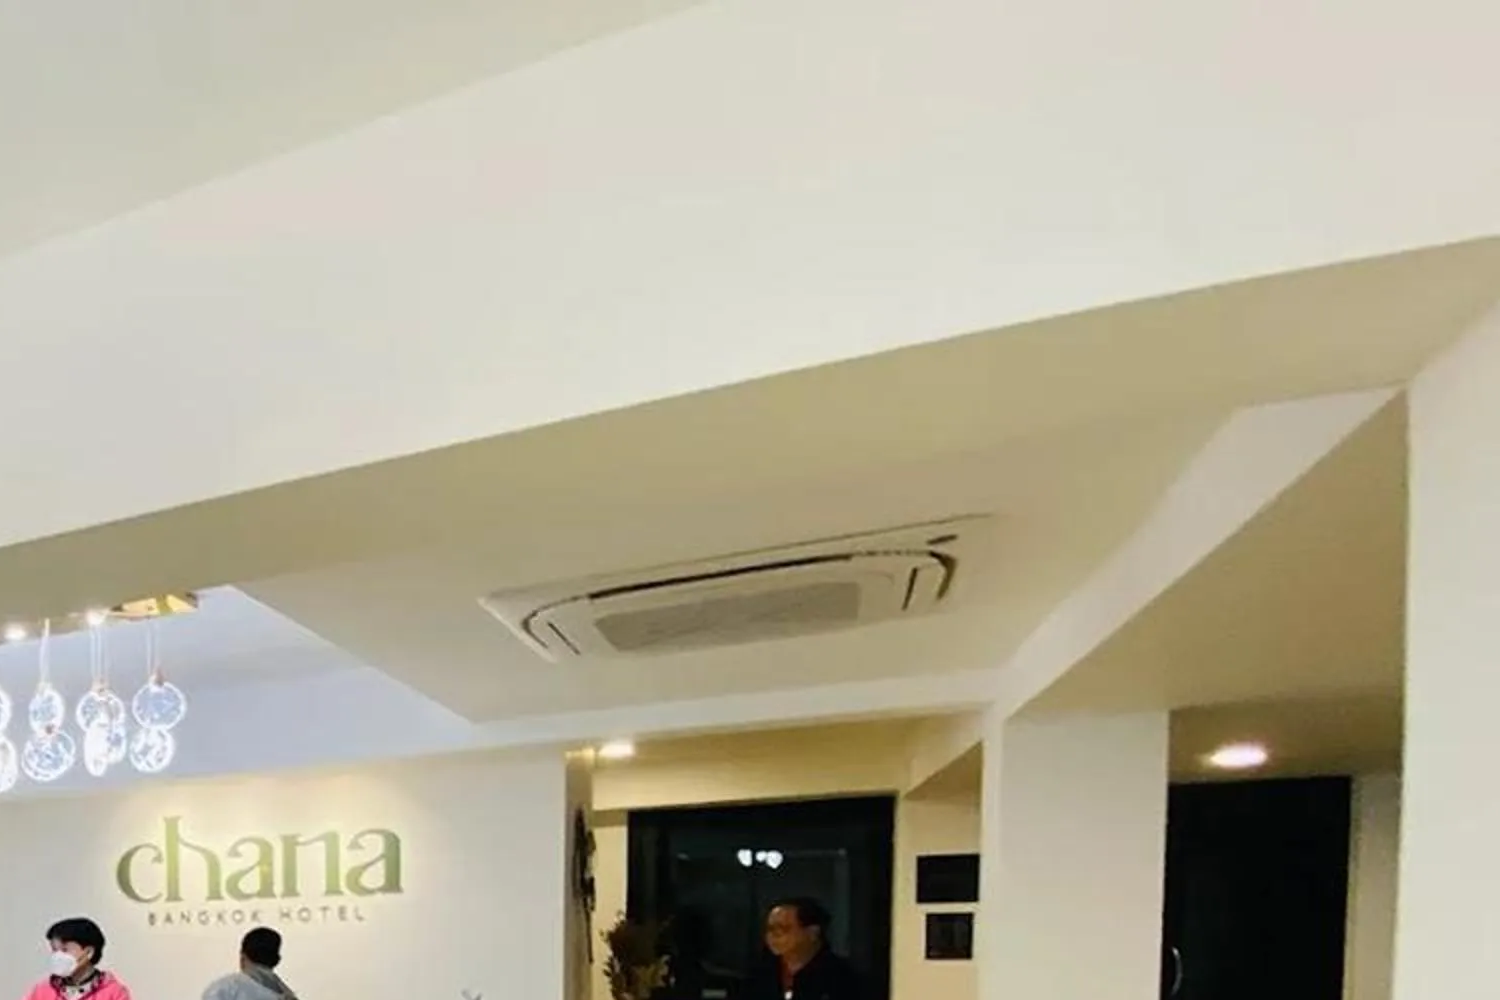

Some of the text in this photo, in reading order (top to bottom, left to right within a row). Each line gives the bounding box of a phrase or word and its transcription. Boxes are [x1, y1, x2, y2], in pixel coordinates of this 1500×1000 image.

[116, 815, 404, 903] chana
[148, 905, 365, 926] BANGKOK HOTEL
